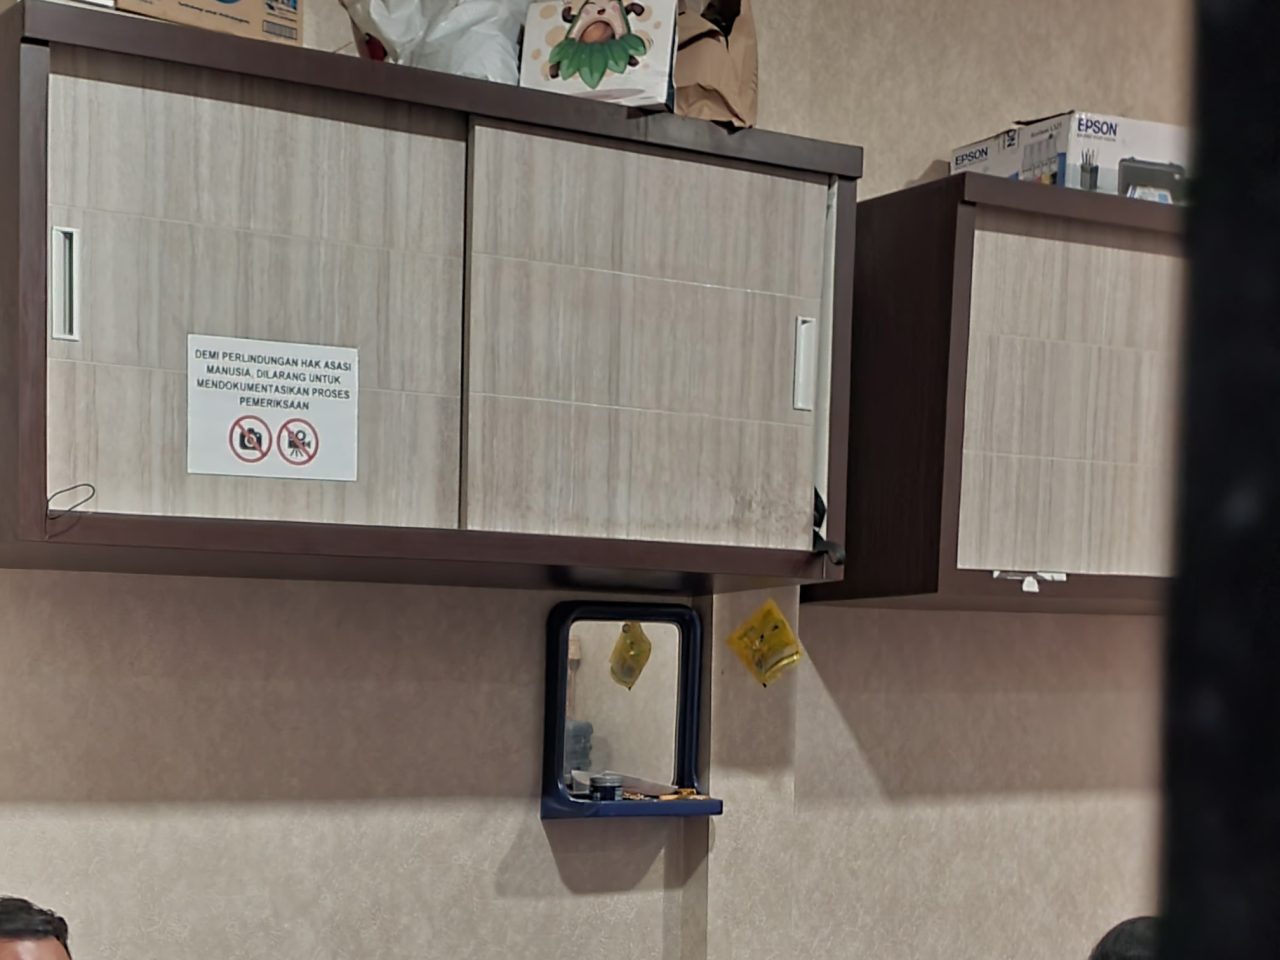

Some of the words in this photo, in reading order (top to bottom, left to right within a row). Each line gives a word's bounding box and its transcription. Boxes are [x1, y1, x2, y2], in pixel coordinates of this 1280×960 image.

[1078, 118, 1117, 136] EPSON
[955, 146, 989, 166] EPSON
[195, 349, 219, 360] DEMI
[222, 352, 299, 367] PERLINDUNGAN
[301, 359, 321, 368] HAK
[323, 361, 352, 372] ASASI
[256, 369, 306, 382] DILARANG
[308, 374, 341, 385] UNTUK
[196, 378, 310, 397] MENDOKUMENTASIKAN
[312, 387, 350, 399] PROSES
[239, 396, 310, 410] PEMERIKSAAN
